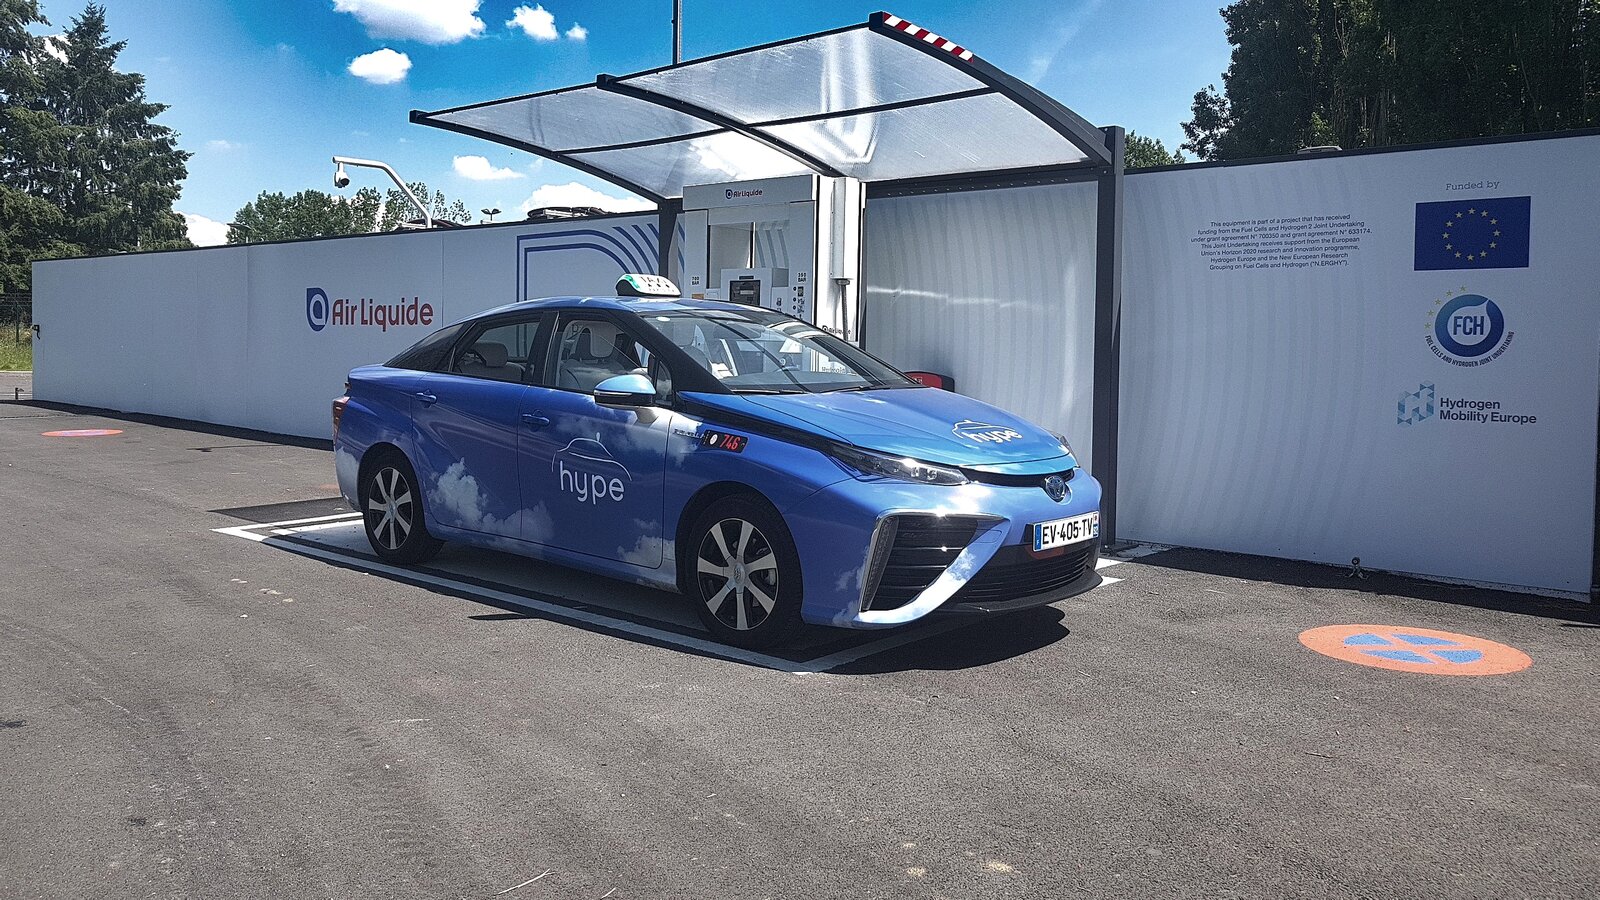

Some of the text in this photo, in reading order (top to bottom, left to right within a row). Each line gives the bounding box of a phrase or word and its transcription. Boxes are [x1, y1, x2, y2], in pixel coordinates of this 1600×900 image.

[1446, 180, 1500, 191] Funded by
[742, 190, 763, 198] Liquide
[332, 297, 433, 332] Air Liquide
[1452, 316, 1484, 335] FCH
[1424, 331, 1514, 367] FUEL CELLS AND HYDROGEN JOINT UNDERTAKING
[1440, 398, 1500, 410] Hydrogen
[1440, 410, 1537, 425] Mobility Europe
[720, 434, 741, 450] 746
[961, 431, 1023, 443] hype
[560, 460, 625, 505] hype
